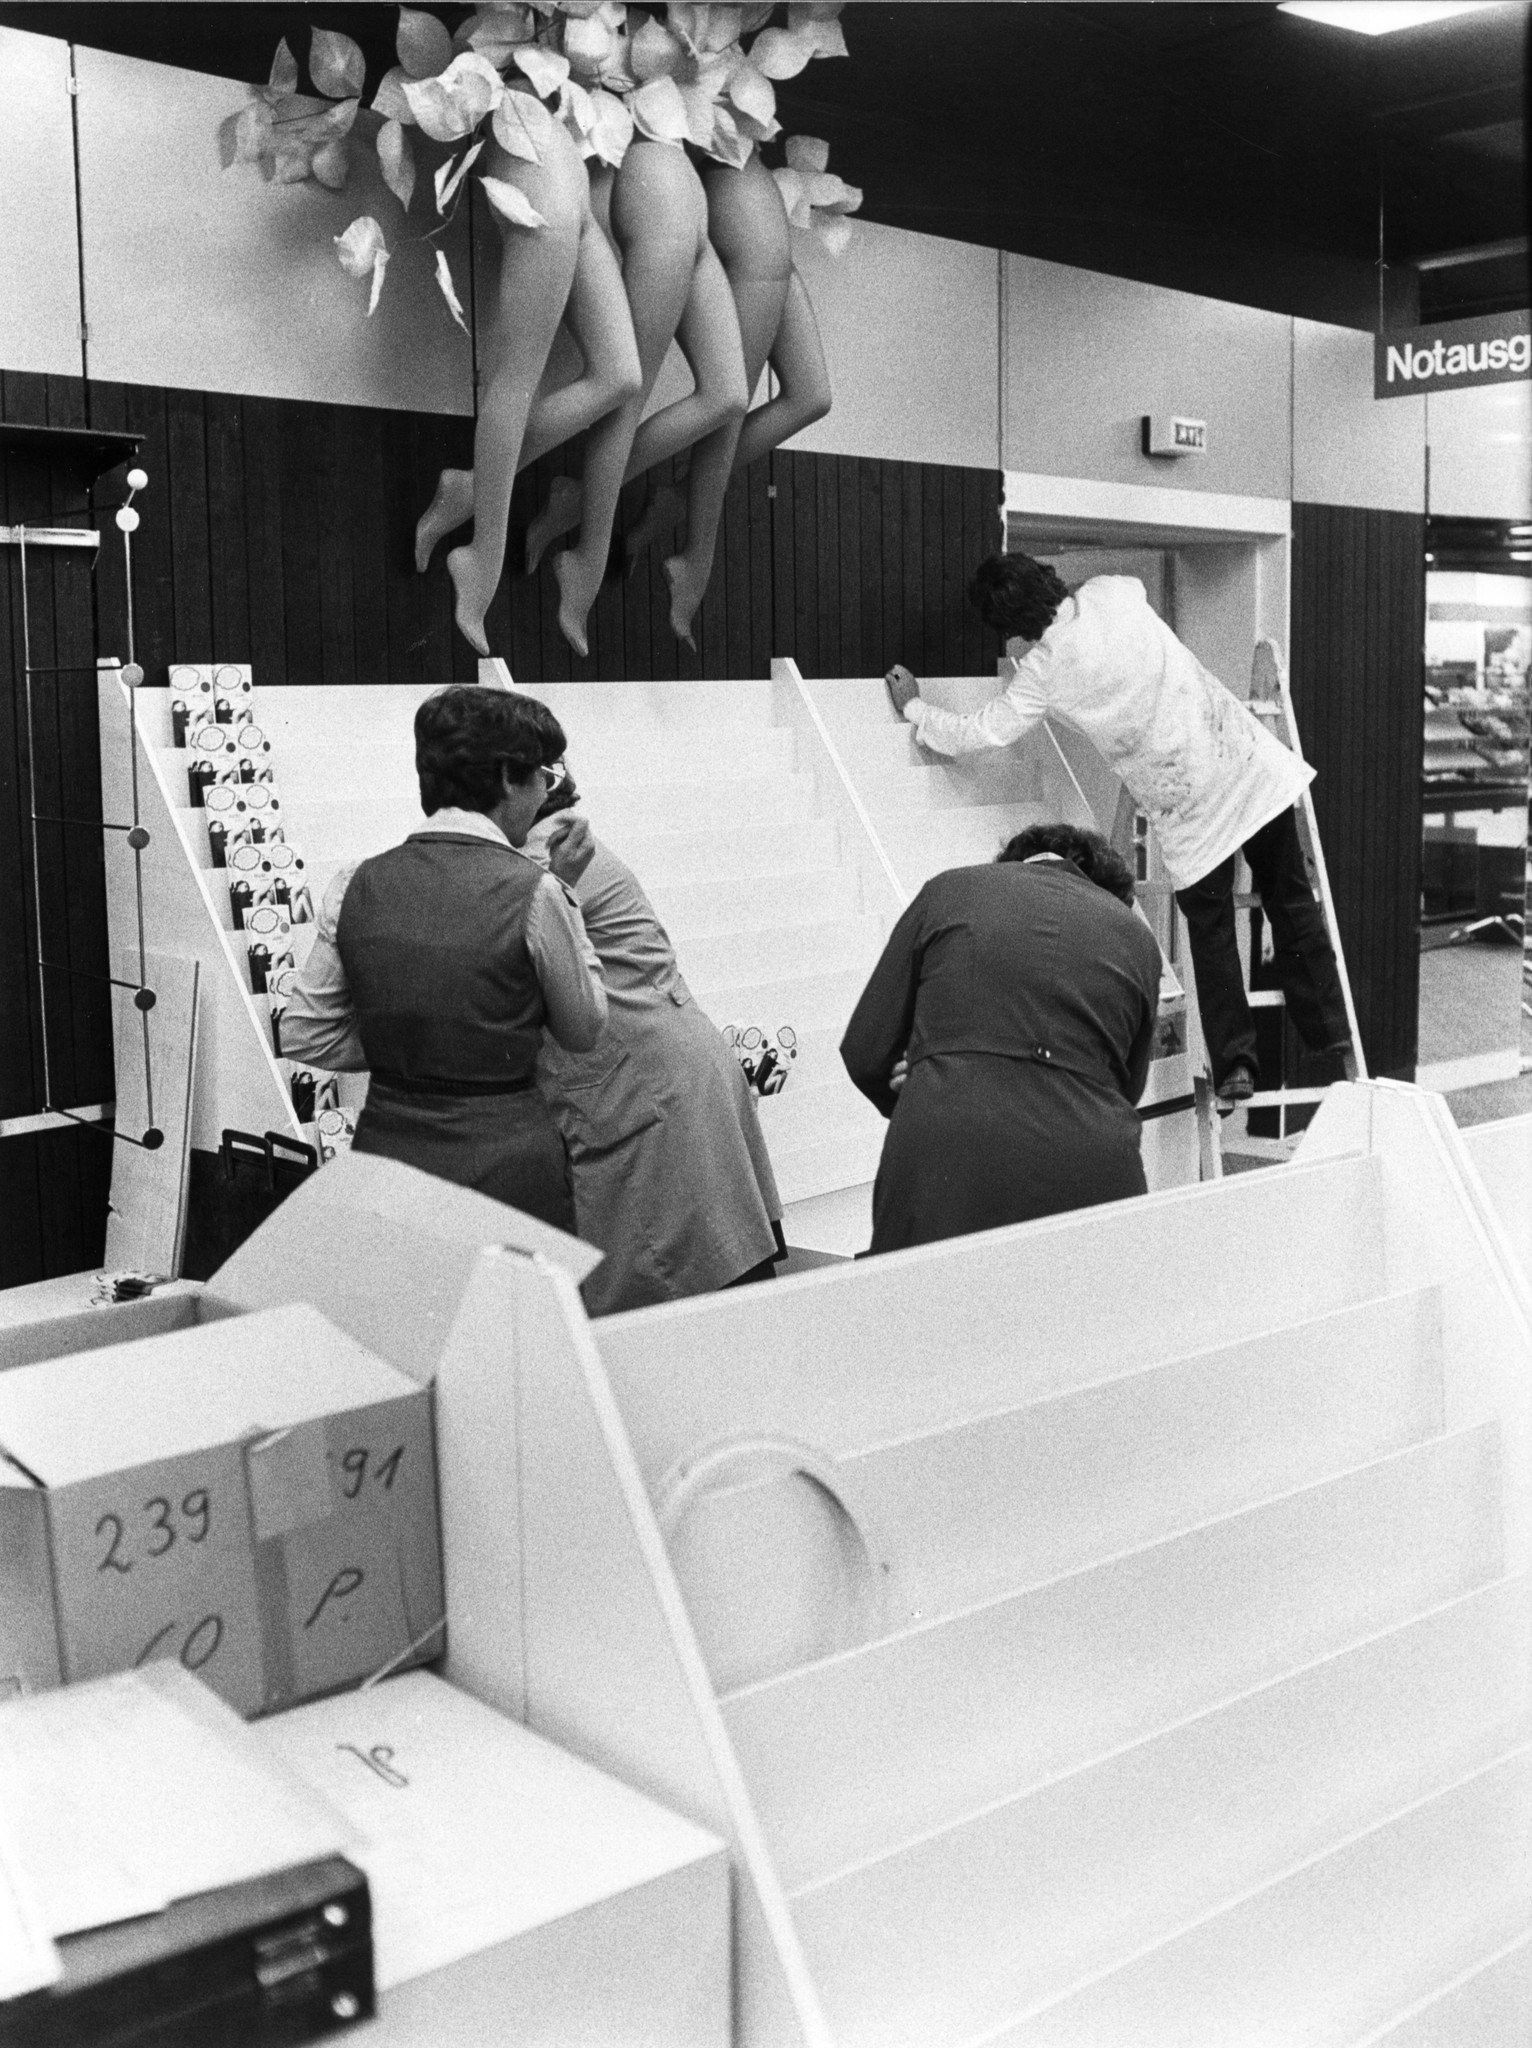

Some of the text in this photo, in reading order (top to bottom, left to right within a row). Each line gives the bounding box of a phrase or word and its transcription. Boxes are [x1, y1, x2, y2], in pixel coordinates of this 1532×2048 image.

[1386, 334, 1531, 382] Notausg
[1175, 423, 1203, 447] EXIT
[342, 1446, 405, 1499] 91
[95, 1488, 211, 1573] 239
